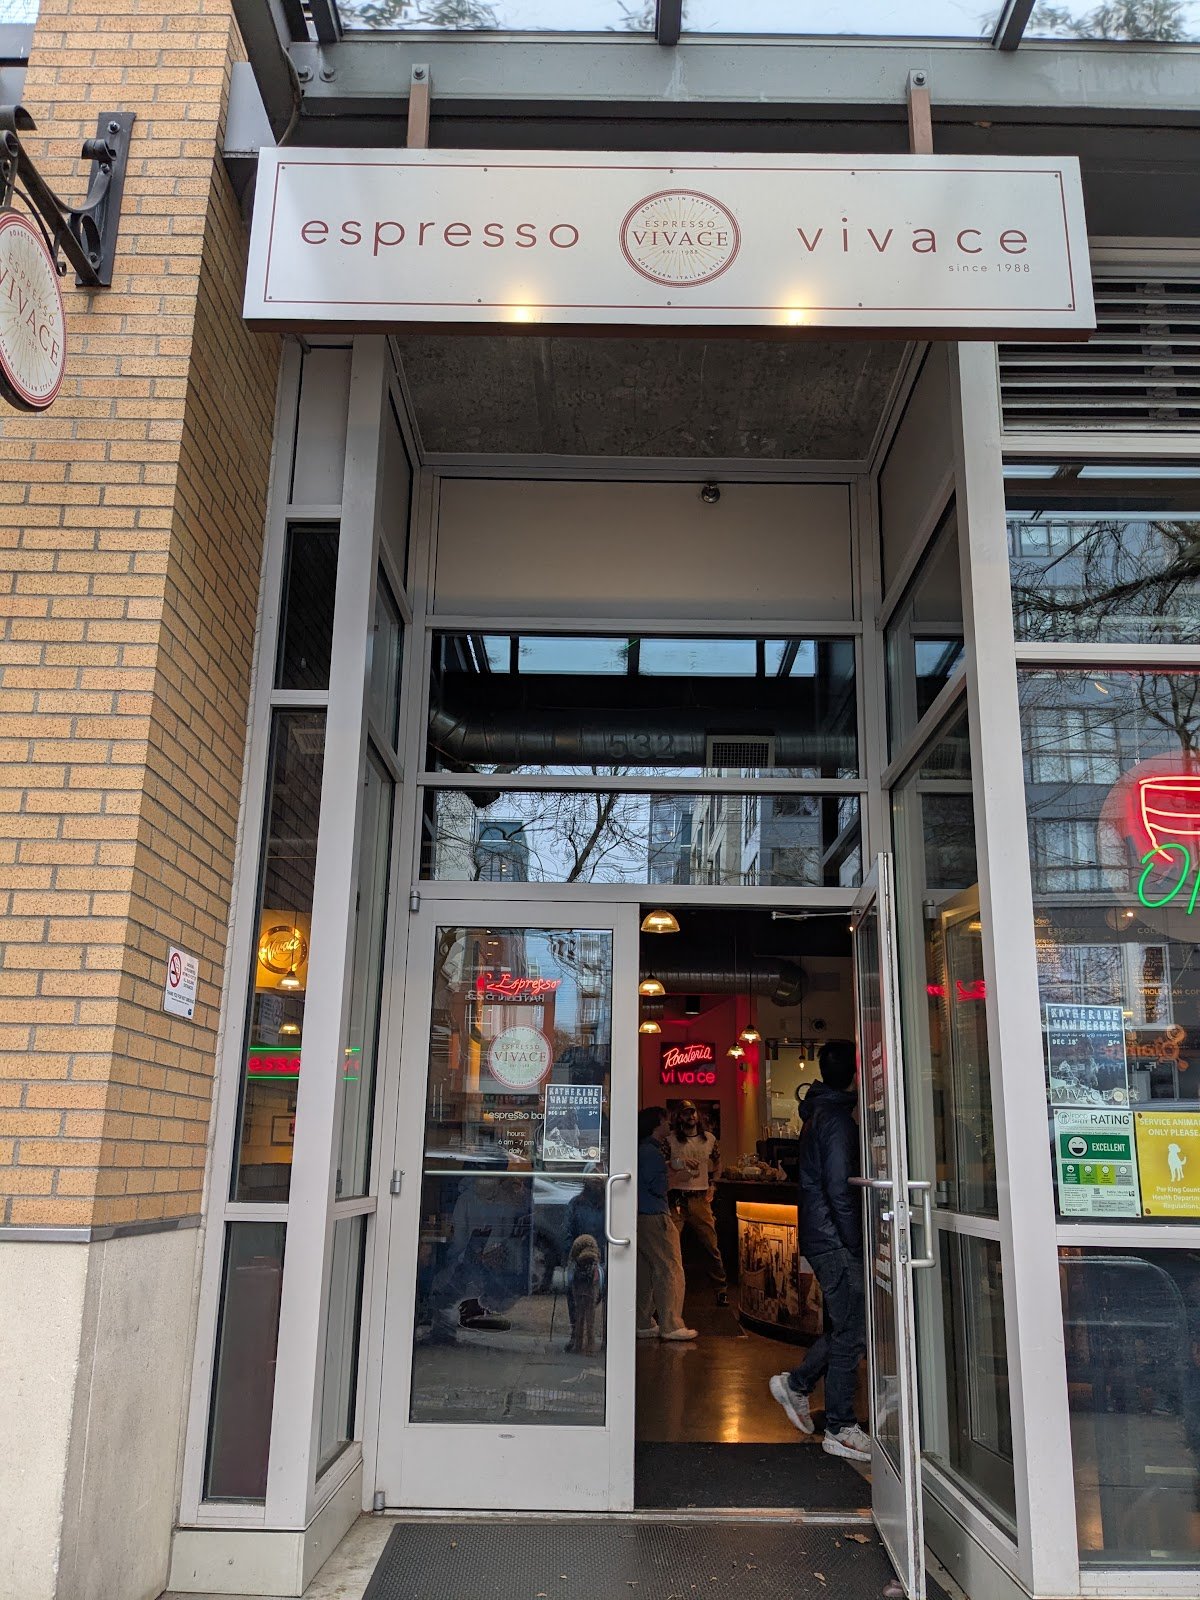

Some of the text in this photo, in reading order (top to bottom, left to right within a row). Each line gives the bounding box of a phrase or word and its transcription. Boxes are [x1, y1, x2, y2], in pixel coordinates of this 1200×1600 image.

[645, 220, 715, 228] ESPRESSO
[301, 219, 579, 257] espresso
[631, 231, 728, 246] VIVACE
[797, 217, 1029, 254] vivace
[948, 263, 1031, 273] since 1988
[9, 252, 55, 327] ESPRESSO
[606, 732, 675, 759] 532
[494, 1051, 546, 1062] VIVACE
[488, 1111, 529, 1121] espresso
[1090, 1114, 1130, 1125] RATING
[1140, 1118, 1171, 1126] SERVICE
[1148, 1128, 1169, 1136] ONLY
[1091, 1142, 1126, 1152] EXCELLENT
[1167, 1186, 1181, 1194] King
